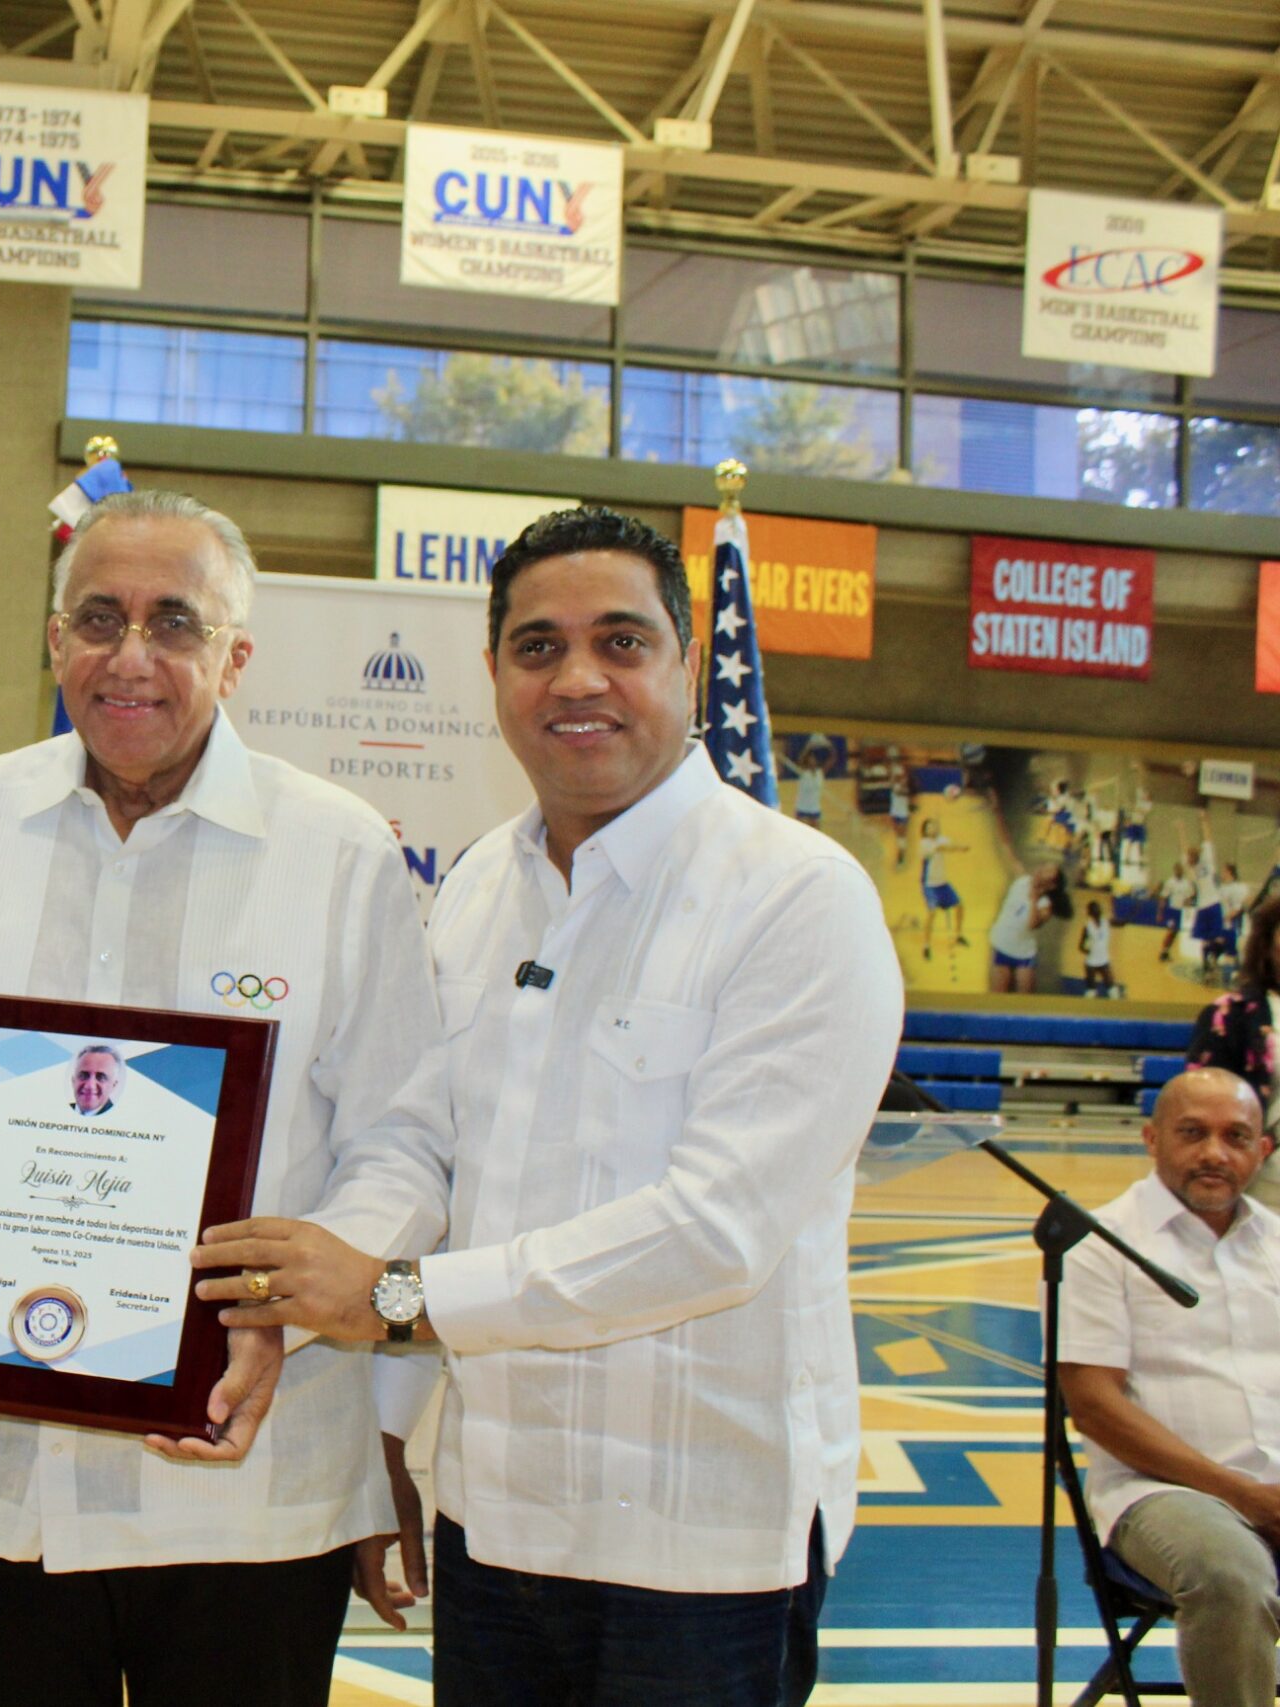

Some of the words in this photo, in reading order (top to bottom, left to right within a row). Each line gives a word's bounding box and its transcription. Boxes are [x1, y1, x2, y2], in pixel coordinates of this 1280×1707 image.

[434, 170, 595, 233] CUNY
[410, 231, 496, 254] WOMEN'S
[500, 237, 613, 267] BASKETBALL
[459, 257, 563, 283] CHAMPIONS
[1069, 245, 1182, 295] ECAC
[1096, 303, 1200, 330] BASKETBALL
[1070, 323, 1167, 348] CHAMPIONS
[794, 564, 869, 618] EVERS
[993, 559, 1096, 608] COLLEGE
[1100, 567, 1135, 611] OF
[972, 612, 1059, 660] STATEN
[1063, 618, 1148, 668] ISLAND
[326, 697, 408, 712] GOBIERNO
[414, 701, 432, 714] DE
[439, 703, 459, 716] LA
[248, 706, 377, 732] REPÚBLICA
[386, 716, 501, 739] DOMINICA
[329, 757, 455, 782] DEPORTES
[8, 1118, 37, 1128] UNIÓN
[39, 1122, 89, 1134] DEPORTIVA
[91, 1127, 151, 1141] DOMINICANA
[153, 1134, 165, 1142] NY
[36, 1146, 46, 1154] En
[48, 1147, 116, 1162] Reconocimiento
[118, 1155, 128, 1163] A:
[2, 1222, 10, 1231] tu
[12, 1224, 29, 1234] gran
[30, 1225, 50, 1236] labor
[51, 1229, 71, 1238] como
[72, 1230, 115, 1243] Co-Creador
[116, 1235, 125, 1244] de
[127, 1239, 155, 1249] nuestra
[46, 1215, 74, 1225] nombre
[76, 1217, 85, 1227] de
[87, 1219, 108, 1230] todos
[109, 1221, 120, 1230] los
[121, 1223, 164, 1237] deportistas
[165, 1228, 175, 1238] de
[31, 1245, 58, 1256] Agosto
[42, 1256, 59, 1266] New
[61, 1258, 77, 1268] York
[109, 1288, 148, 1301] Eridenia
[150, 1292, 170, 1303] Lora
[116, 1300, 160, 1313] Secretaria
